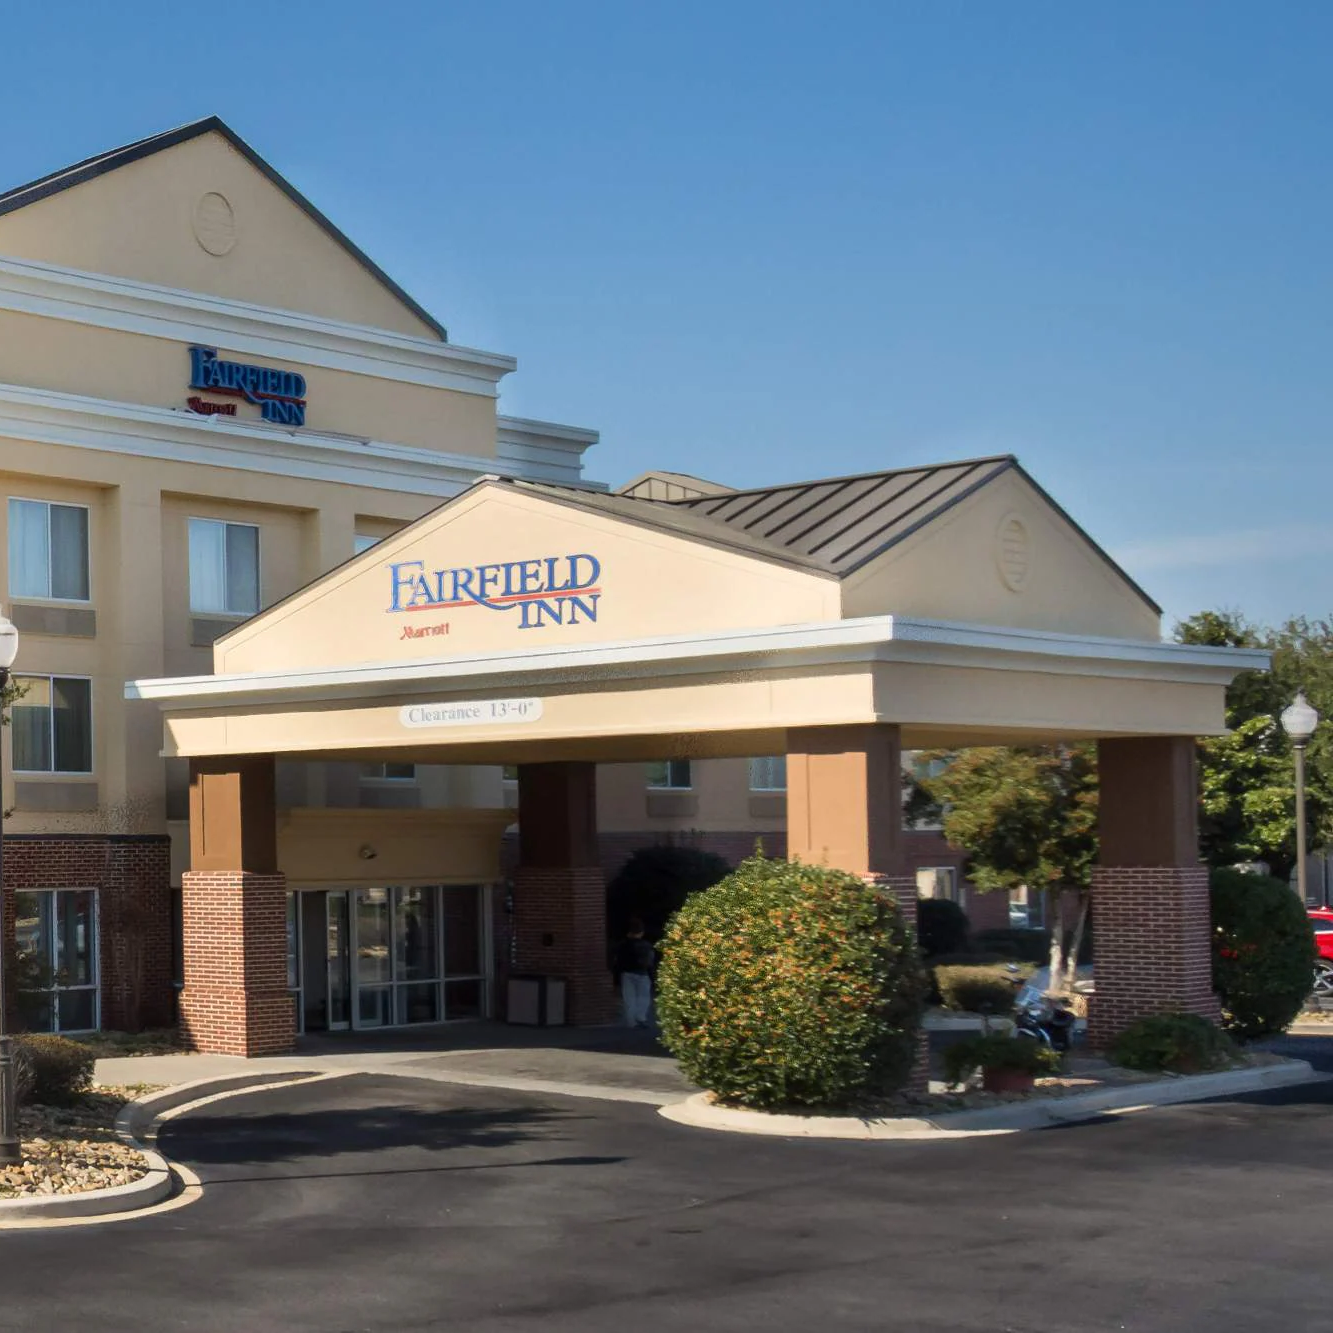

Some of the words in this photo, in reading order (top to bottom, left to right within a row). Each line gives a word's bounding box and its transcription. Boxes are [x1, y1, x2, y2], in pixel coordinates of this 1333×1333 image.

[188, 346, 307, 402] FAIRFIELD
[262, 400, 305, 426] INN
[386, 553, 601, 613] FAIRFIELD
[517, 595, 601, 629] INN
[408, 707, 481, 723] Clearance
